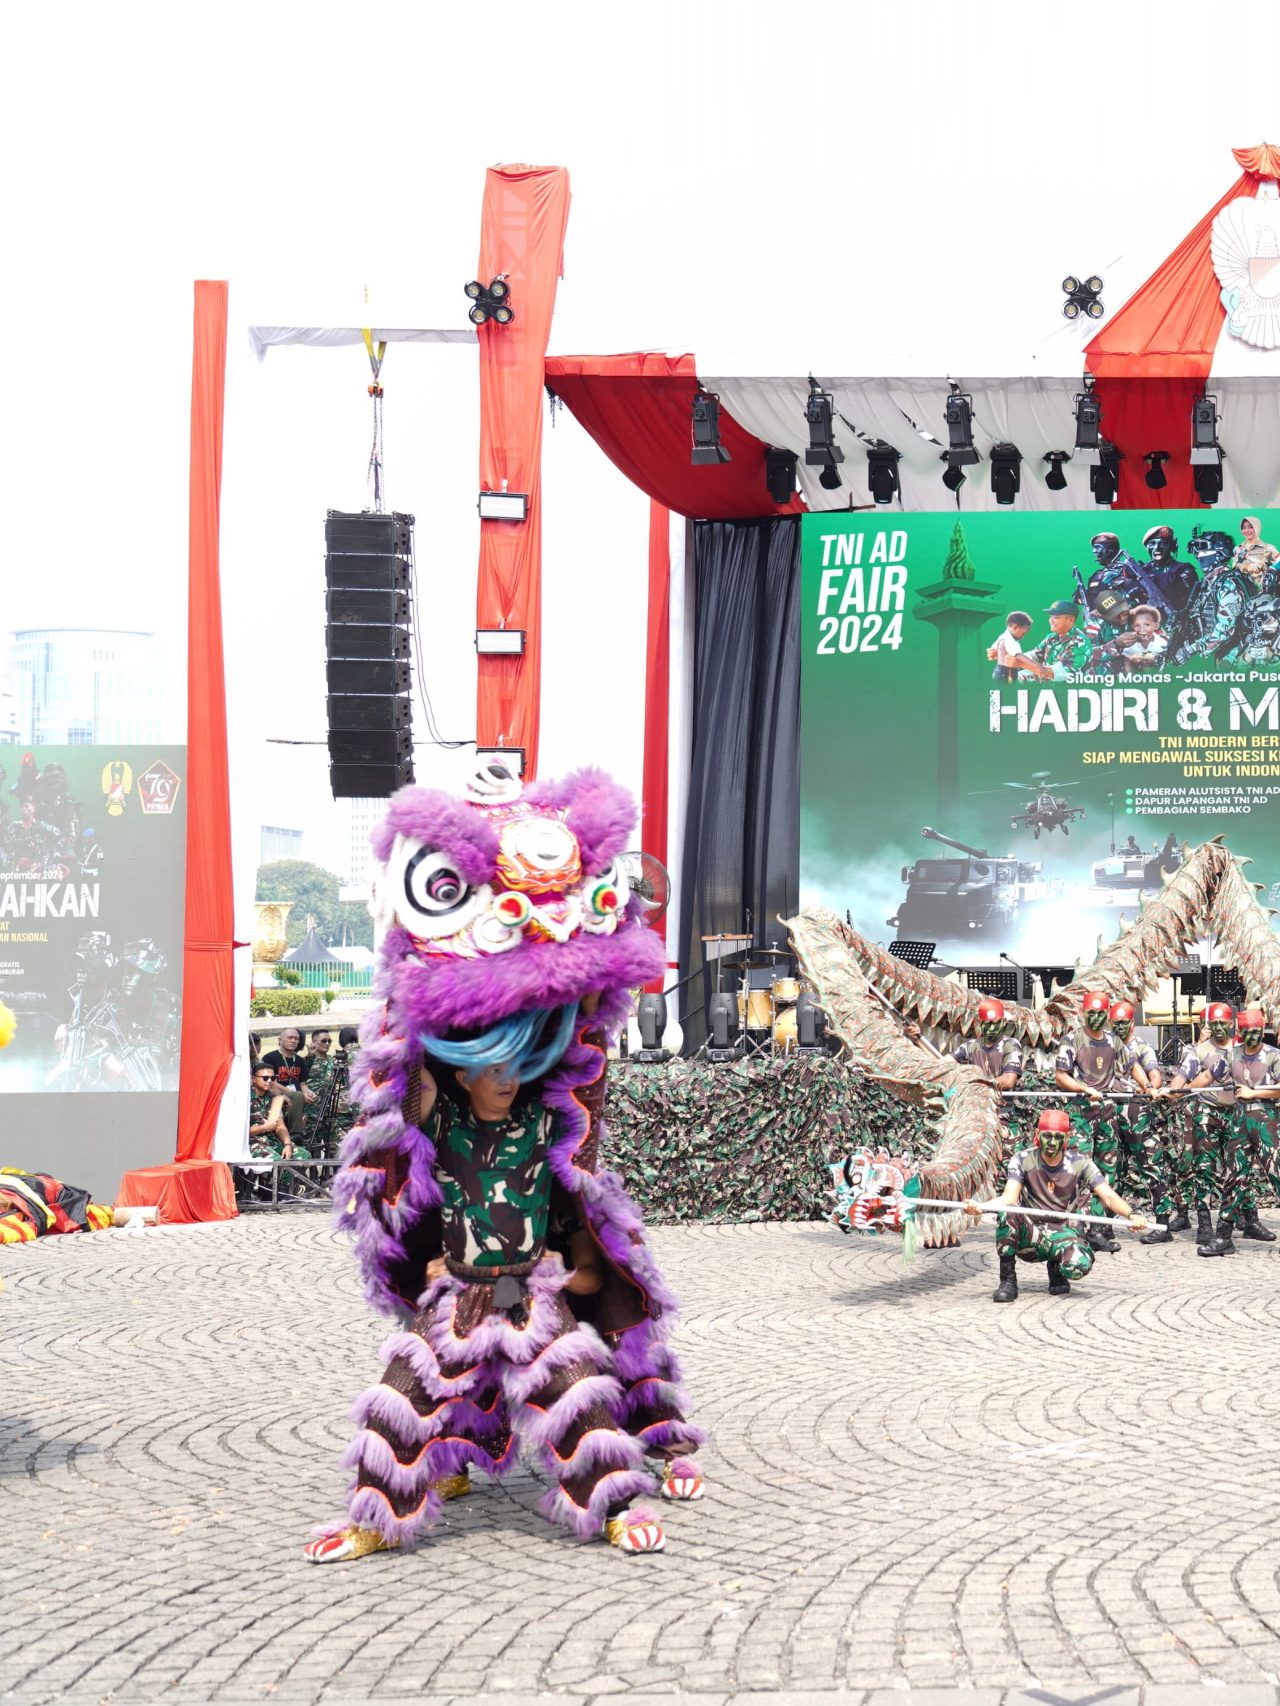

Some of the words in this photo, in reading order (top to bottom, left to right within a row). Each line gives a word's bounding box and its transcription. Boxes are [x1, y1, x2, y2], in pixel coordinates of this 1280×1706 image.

[820, 533, 864, 566] TNI
[869, 530, 908, 563] AD
[817, 565, 908, 615] FAIR
[816, 613, 903, 655] 2024
[1066, 671, 1115, 687] Silang
[1119, 672, 1171, 683] Monas
[989, 688, 1159, 733] HADIRI
[1176, 687, 1213, 731] &
[1159, 736, 1182, 748] TNI
[1186, 735, 1247, 748] MODERN
[1082, 751, 1115, 764] SIAP
[1119, 751, 1201, 764] MENGAWAL
[1205, 750, 1265, 762] SUKSESI
[1183, 765, 1231, 777] UNTUK
[1135, 787, 1186, 796] PAMERAN
[1188, 787, 1243, 795] ALUTSISTA
[1246, 786, 1263, 795] TNI
[1265, 786, 1280, 794] AD
[1135, 797, 1171, 805] DAPUR
[1173, 796, 1231, 805] LAPANGAN
[1233, 796, 1250, 804] TNI
[1252, 796, 1268, 804] AD
[1135, 806, 1197, 815] PEMBAGIAN
[1200, 805, 1251, 814] SEMBAKO
[11, 932, 48, 942] NASIONAL
